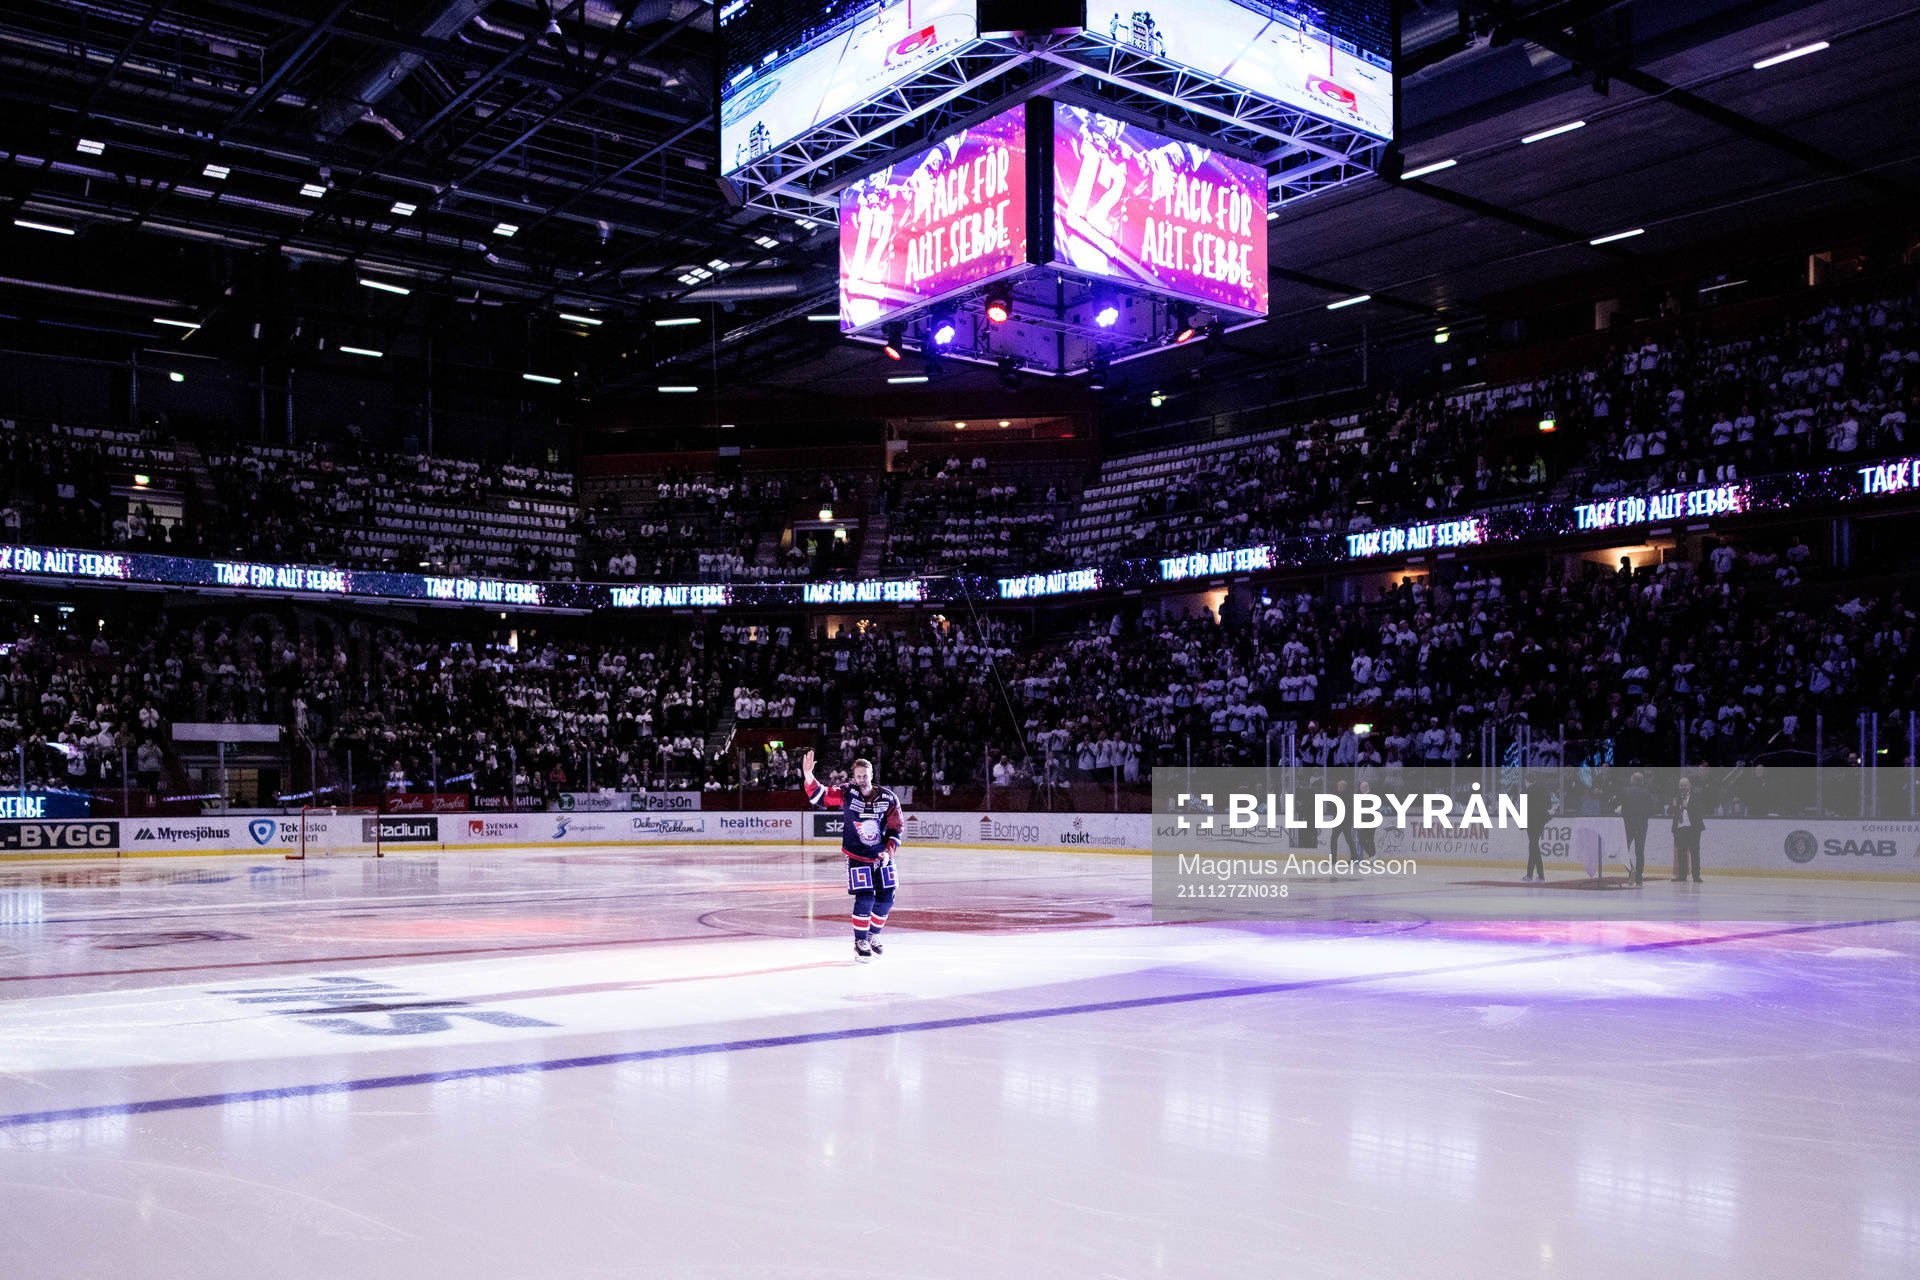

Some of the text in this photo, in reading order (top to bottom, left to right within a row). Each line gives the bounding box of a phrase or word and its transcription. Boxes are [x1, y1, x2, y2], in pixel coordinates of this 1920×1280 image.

[921, 146, 1010, 226] TACK FÖR
[1162, 172, 1252, 237] TACK FÖR
[950, 199, 1011, 268] SEBBE
[1192, 230, 1254, 288] SEBBE
[1857, 461, 1909, 494] TACK
[1573, 486, 1740, 529] TACK FÖR ALLT SEBBE
[1346, 530, 1381, 557] TACK
[1437, 519, 1479, 546] SEBBE
[15, 547, 41, 571] FÖR
[79, 554, 123, 577] SEBBE
[1160, 557, 1188, 580] TACK
[1235, 546, 1270, 571] SEBBE
[214, 563, 249, 584] TACK
[306, 569, 345, 592] SEBBE
[424, 578, 455, 599] TACK
[370, 823, 431, 837] stadium
[486, 822, 518, 830] SVENSKA
[632, 817, 660, 829] Dekor
[659, 819, 695, 834] Reklam
[720, 816, 792, 828] healthcare
[920, 820, 962, 840] Botrygg
[993, 821, 1040, 842] Botrygg
[0, 825, 111, 847] -BYGG
[157, 827, 230, 842] Myresjöhus
[1060, 831, 1090, 844] utsikt
[1823, 838, 1897, 857] SAAB
